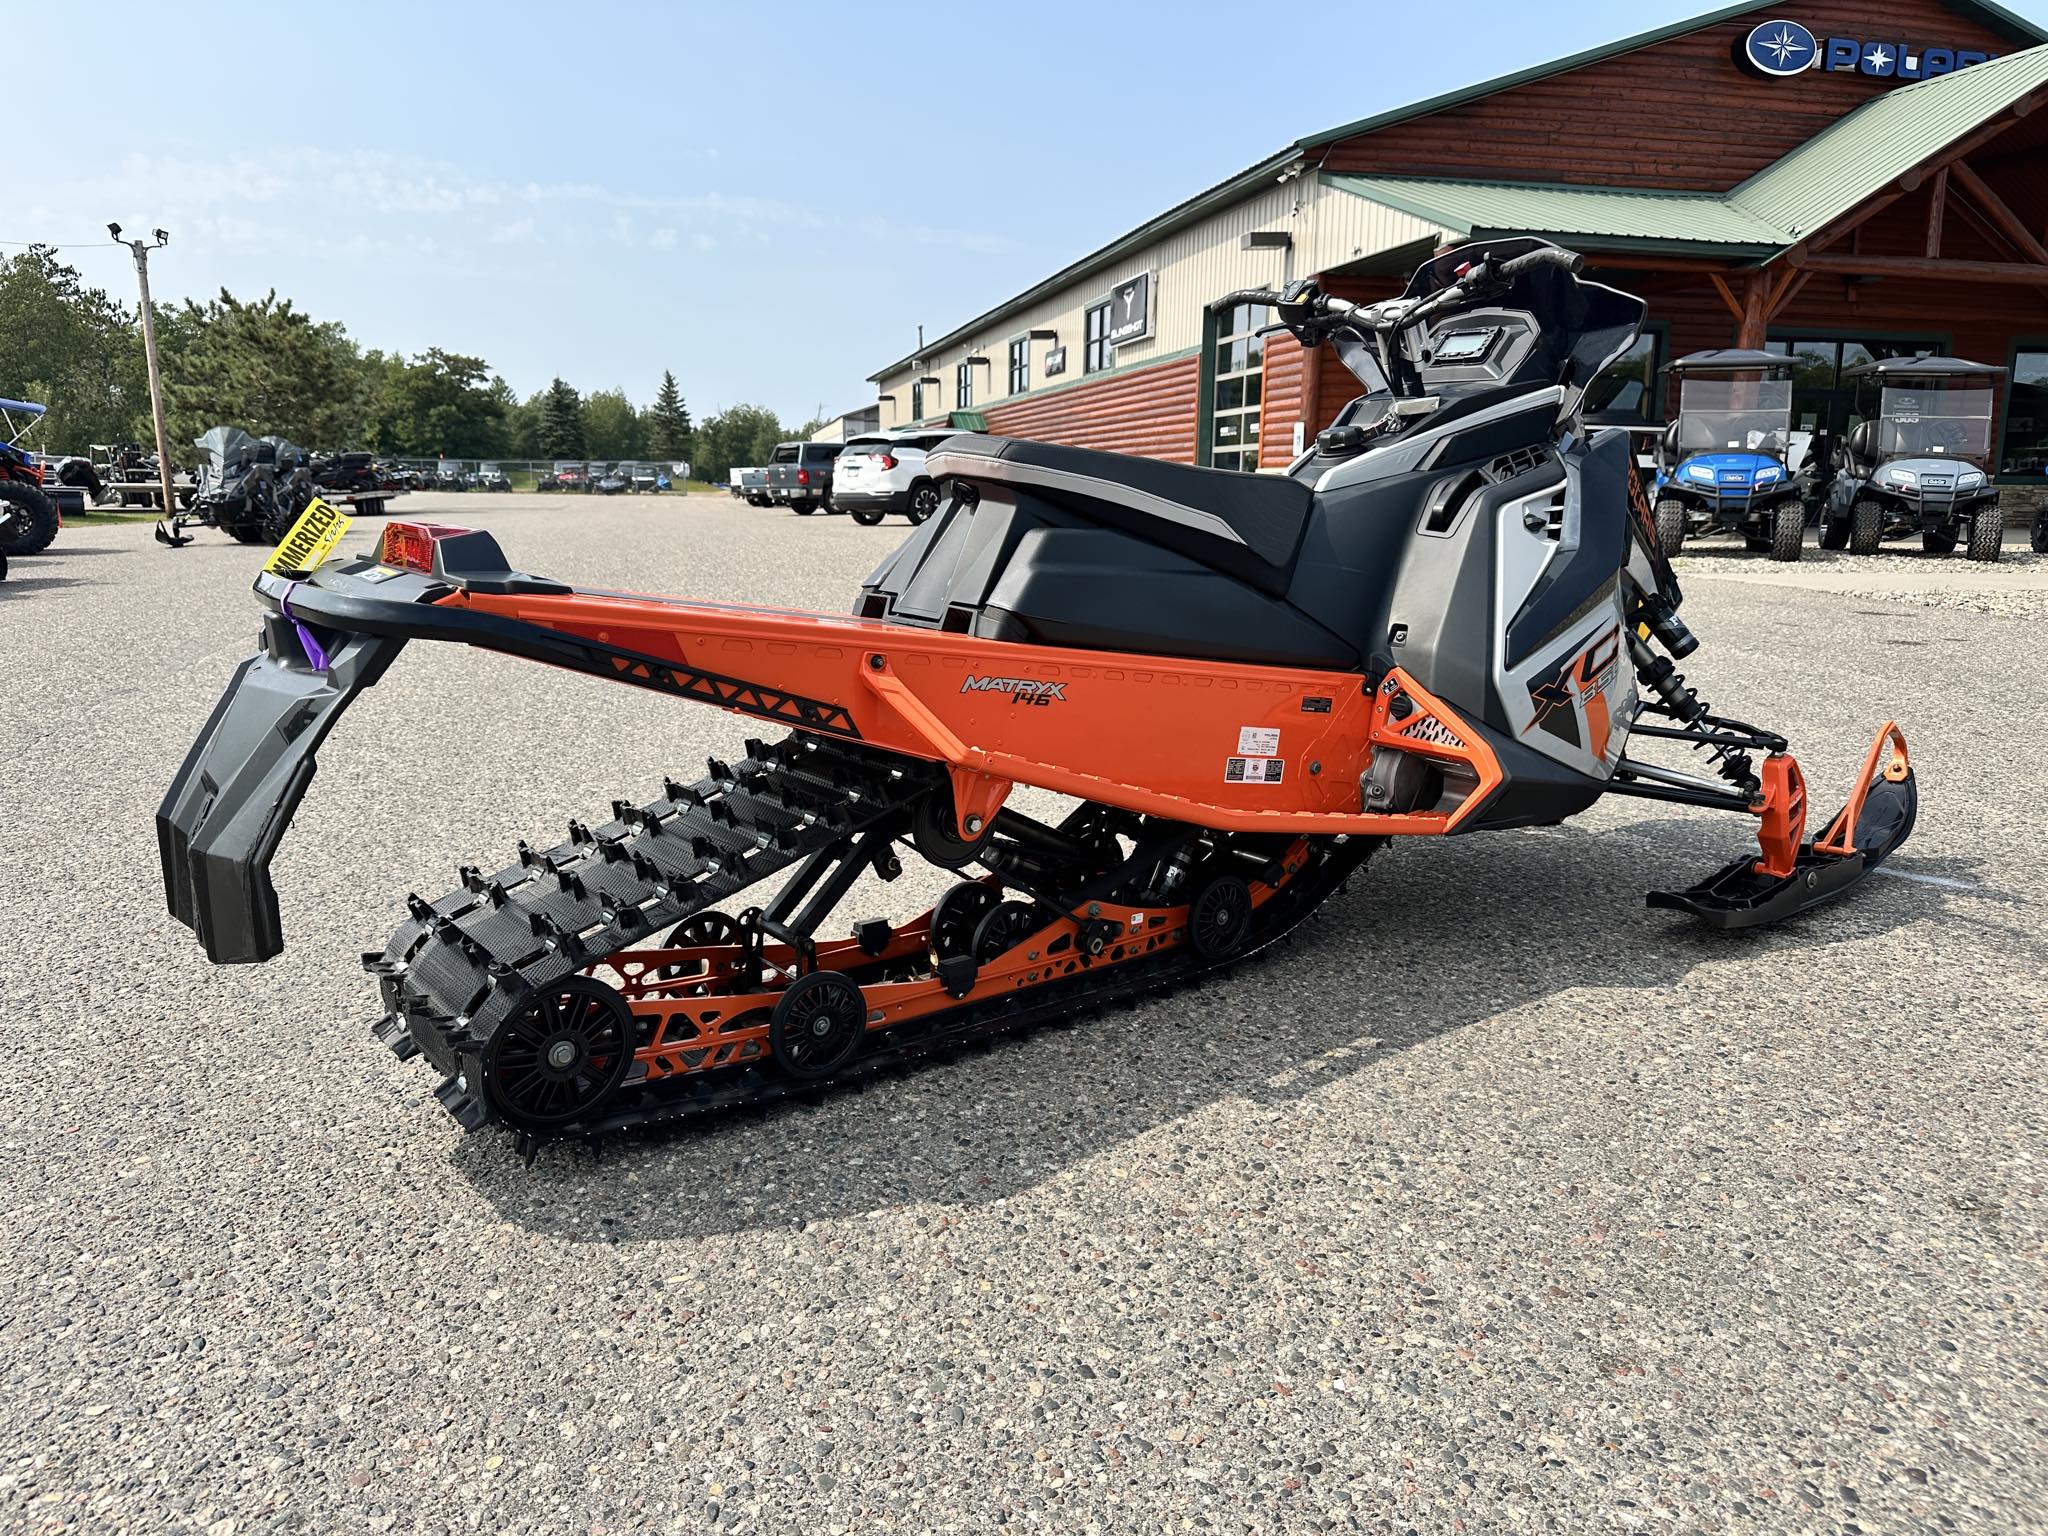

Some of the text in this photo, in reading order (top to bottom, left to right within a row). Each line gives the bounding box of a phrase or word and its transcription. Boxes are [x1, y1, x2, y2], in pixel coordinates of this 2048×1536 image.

[1825, 37, 1999, 80] POLA
[272, 504, 337, 571] MMERIZED
[960, 674, 1068, 701] MATRYX
[1011, 692, 1052, 706] 146
[1520, 621, 1620, 737] XC
